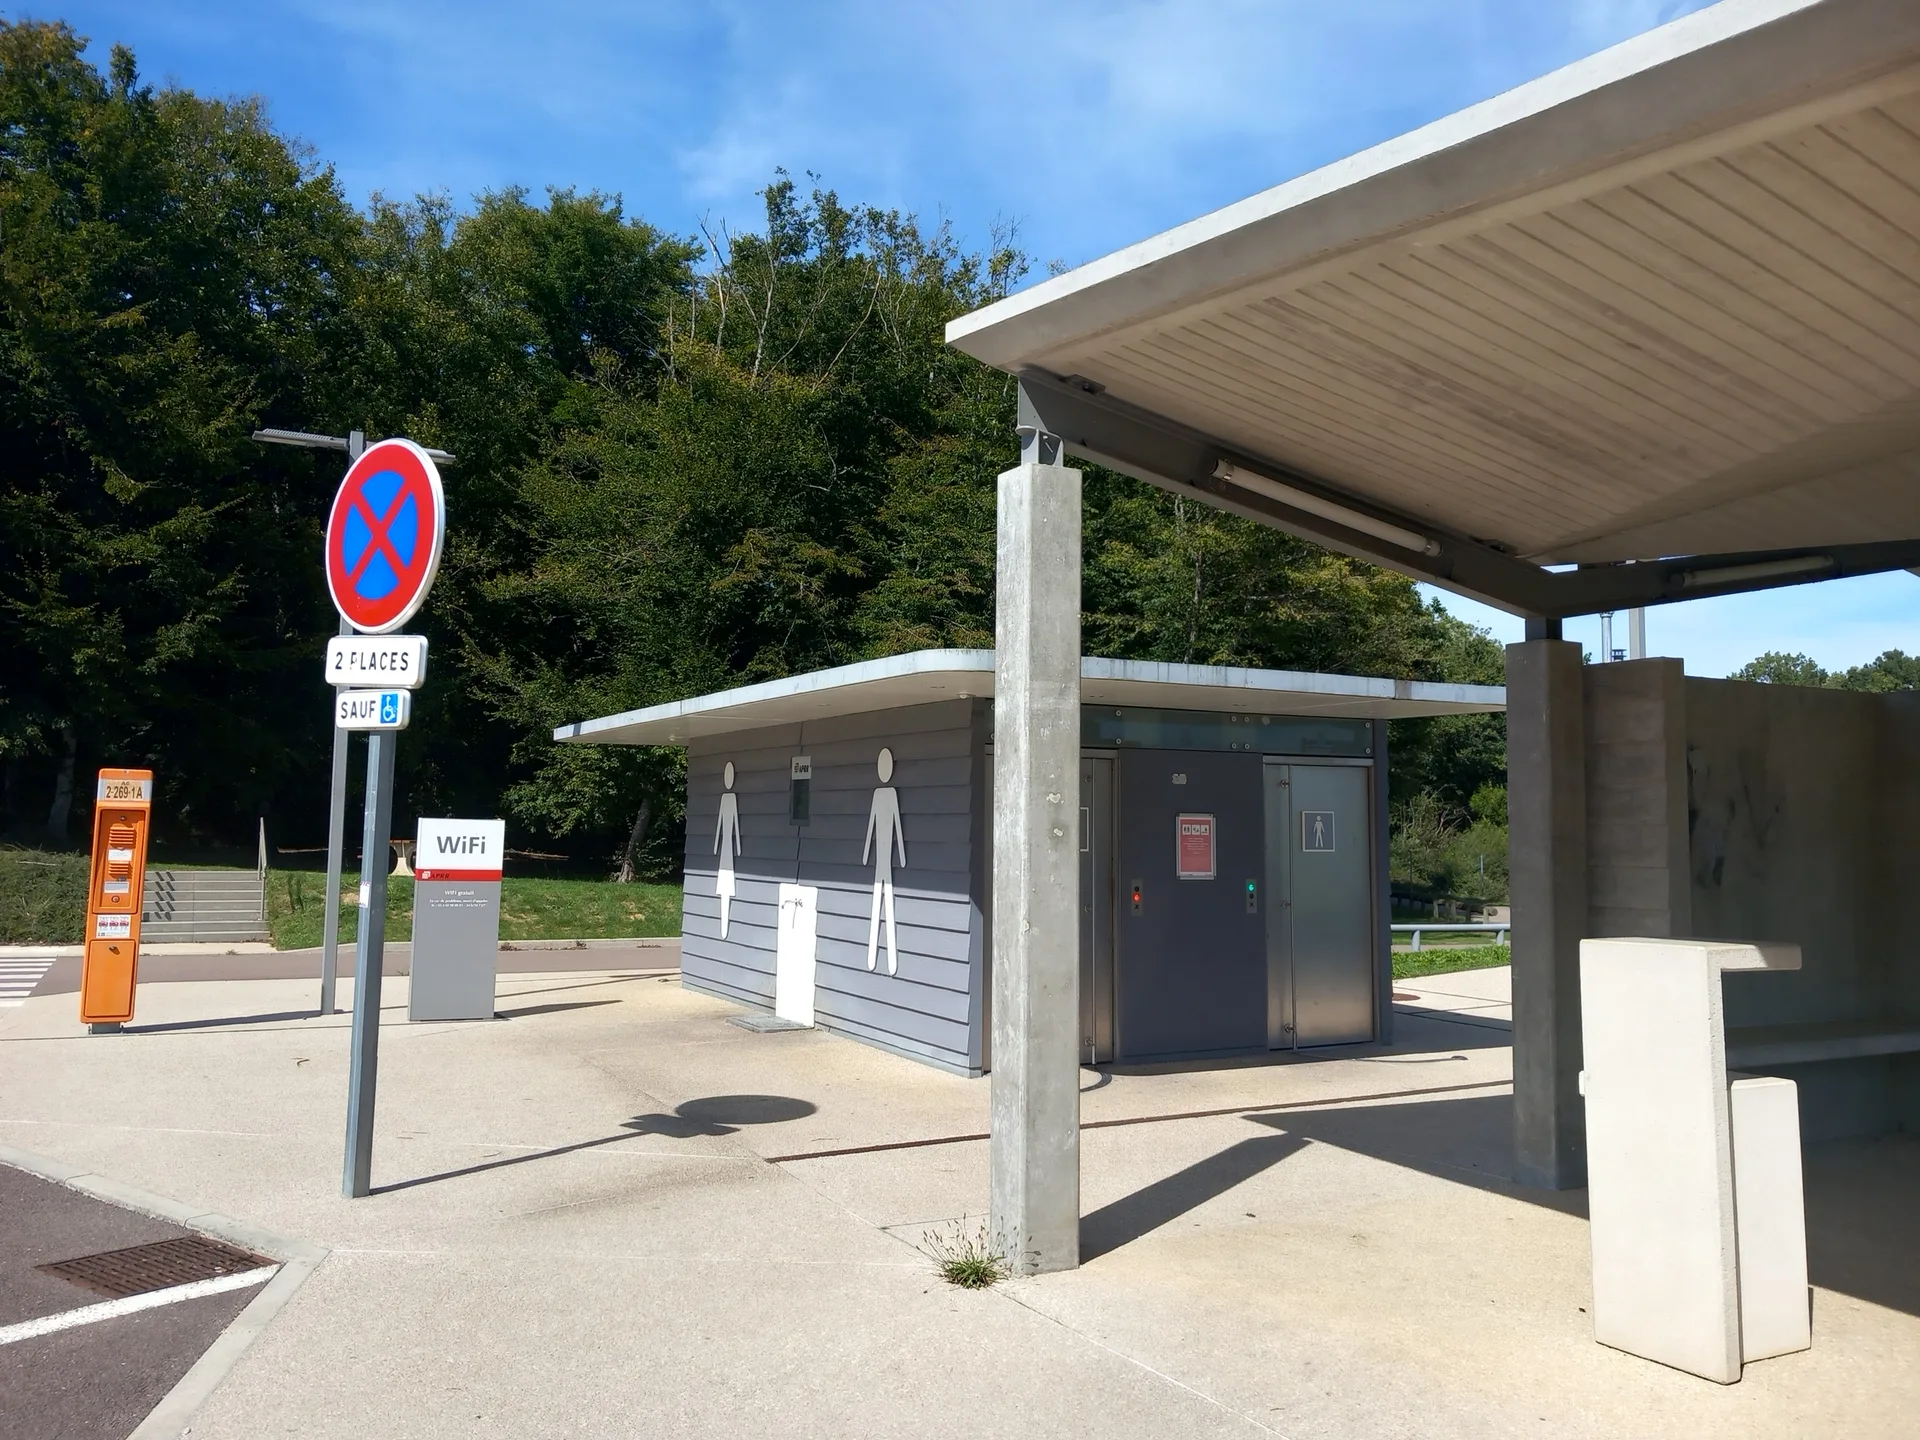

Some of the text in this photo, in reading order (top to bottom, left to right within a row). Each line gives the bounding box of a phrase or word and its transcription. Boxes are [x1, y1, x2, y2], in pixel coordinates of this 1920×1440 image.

[334, 651, 343, 670] 2
[340, 700, 376, 719] SAUF
[436, 836, 486, 854] WiFi
